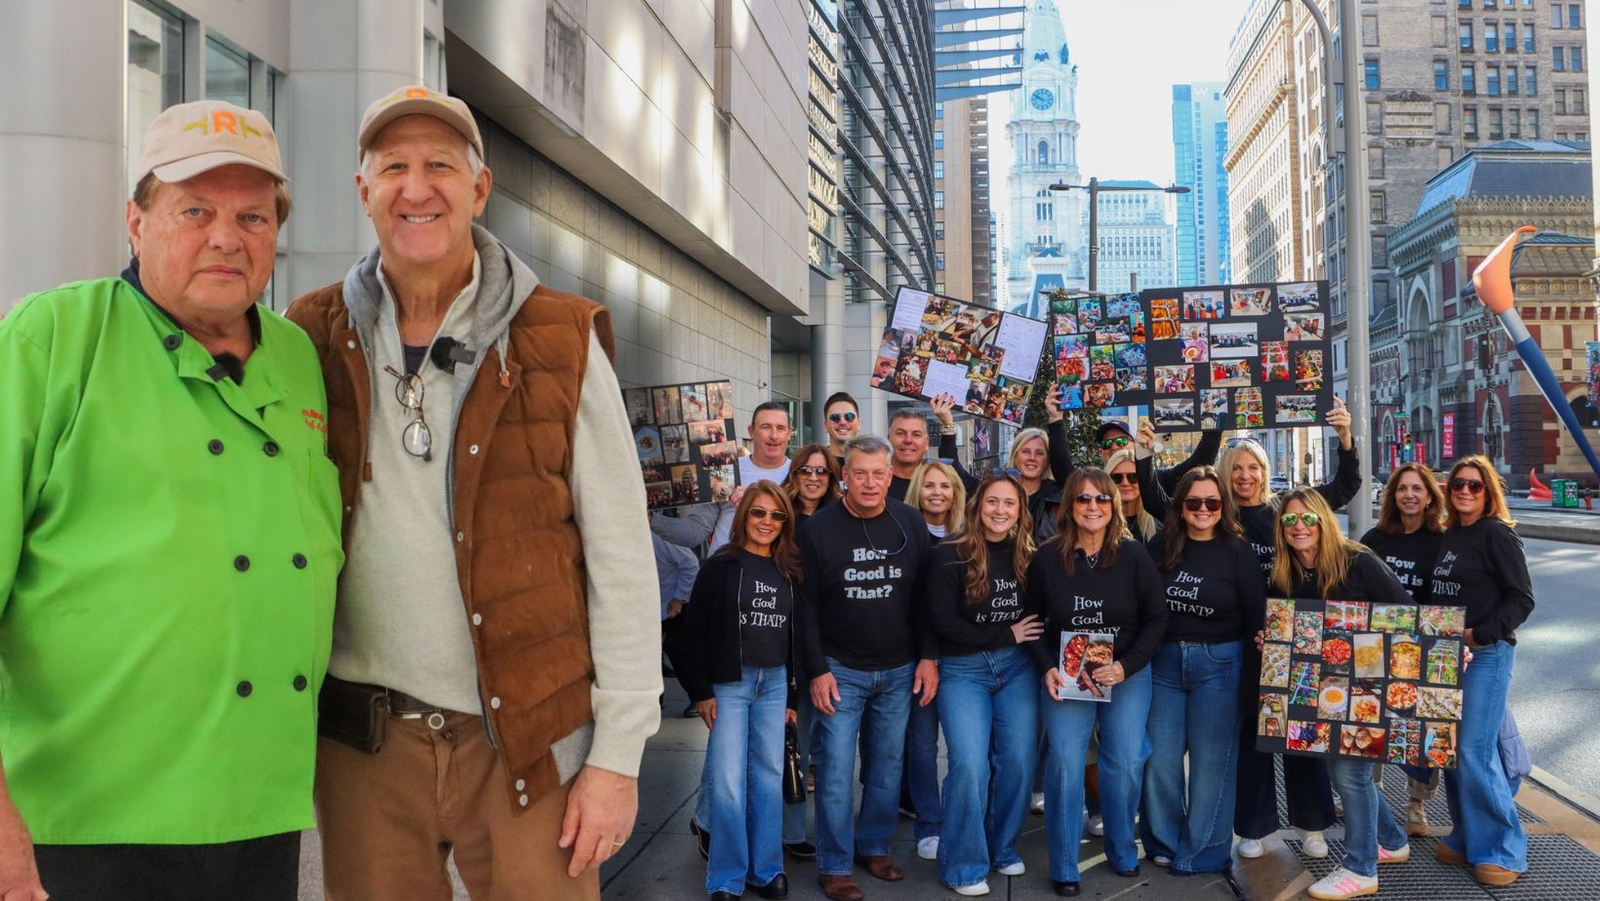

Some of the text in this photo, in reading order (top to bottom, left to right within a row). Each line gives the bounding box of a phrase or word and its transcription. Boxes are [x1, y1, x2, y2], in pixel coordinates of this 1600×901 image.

[1194, 86, 1209, 97] W
[843, 565, 903, 582] Good is
[1173, 570, 1205, 584] How
[1433, 563, 1453, 577] Good
[754, 580, 778, 594] How
[843, 584, 894, 600] That?
[993, 578, 1018, 593] How
[1431, 579, 1462, 597] THAT?
[991, 592, 1019, 609] Good
[1166, 586, 1199, 601] Good
[751, 596, 778, 610] Good
[1072, 595, 1105, 611] How
[1165, 598, 1215, 617] THAT?
[750, 611, 788, 628] THAT?
[975, 612, 988, 623] is
[1071, 611, 1105, 626] Good
